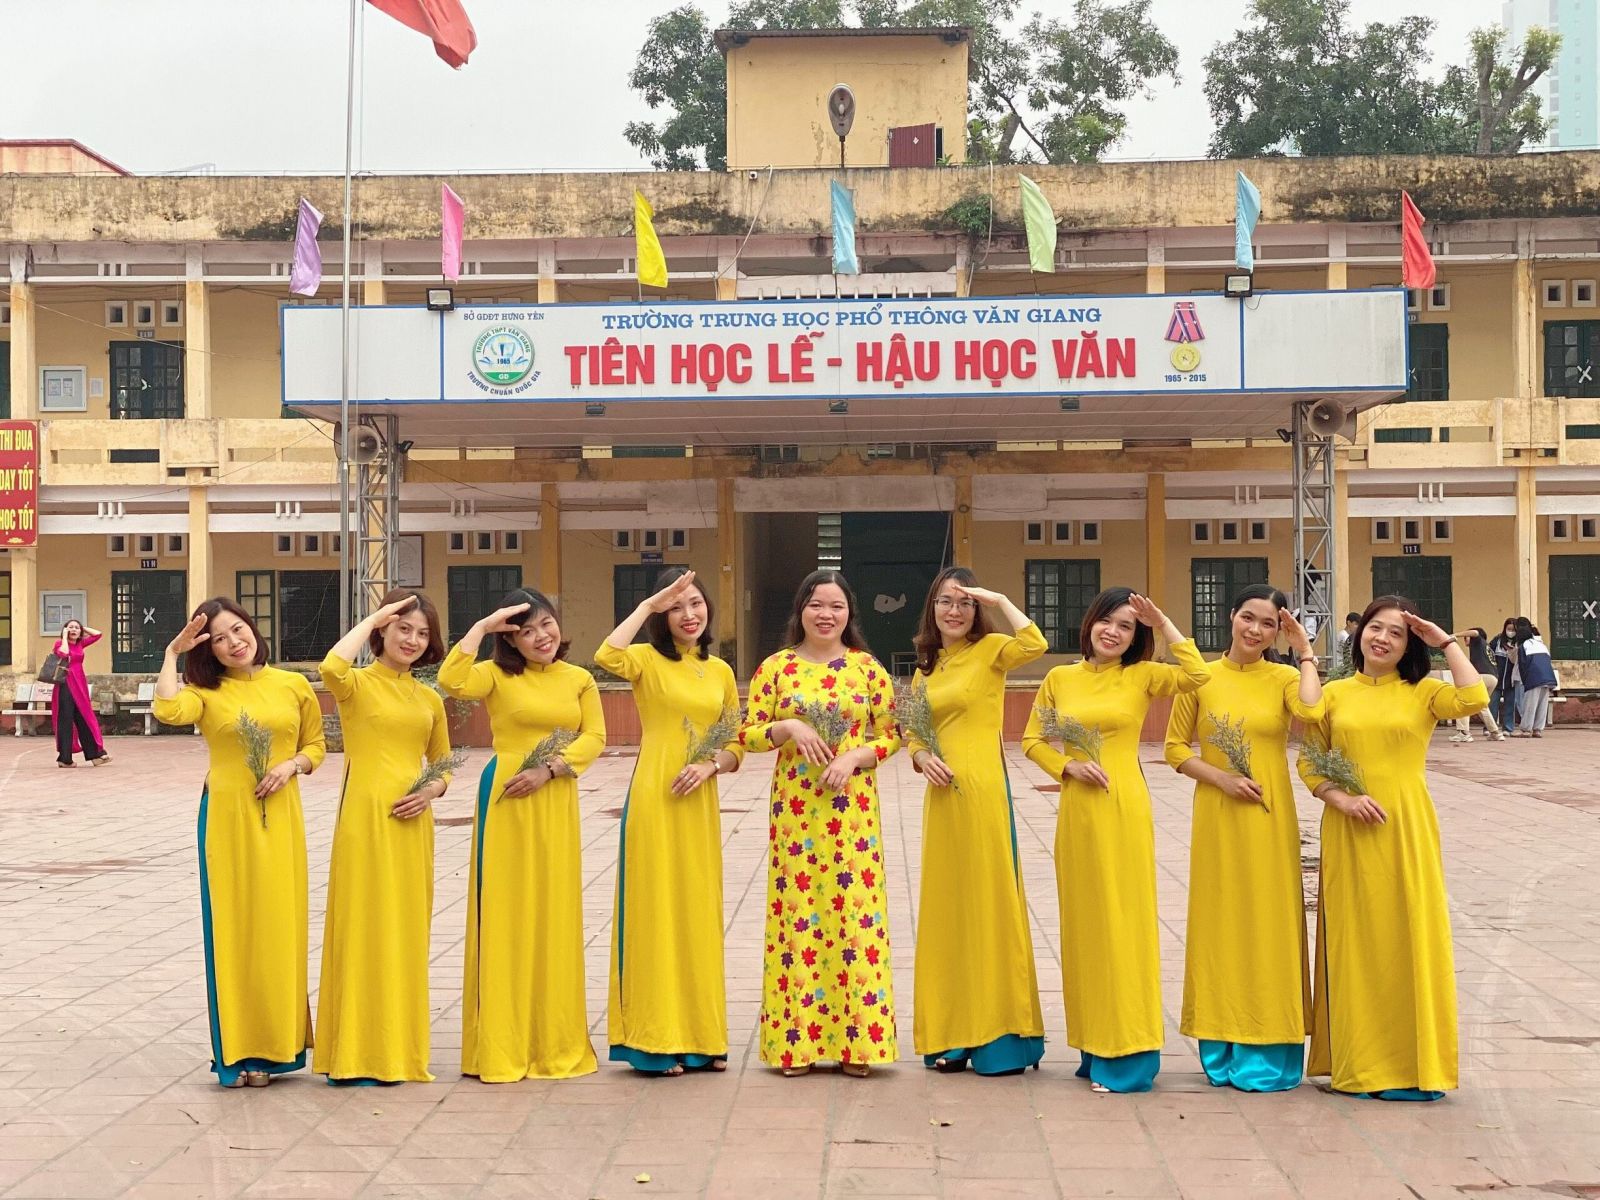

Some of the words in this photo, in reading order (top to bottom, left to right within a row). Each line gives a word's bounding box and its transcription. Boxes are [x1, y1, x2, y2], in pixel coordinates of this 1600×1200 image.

[477, 313, 499, 321] GDĐT
[501, 312, 525, 321] HƯNG
[527, 310, 544, 320] YÊN
[602, 309, 694, 329] TRƯỜNG
[699, 312, 778, 328] TRUNG
[782, 312, 830, 330] HỌC
[835, 303, 883, 326] PHỔ
[888, 306, 968, 325] THÔNG
[973, 306, 1020, 324] VĂN
[1026, 308, 1102, 323] GIANG
[564, 337, 655, 386] TIÊN
[671, 343, 753, 392] HỌC
[768, 331, 825, 384] LỄ
[856, 333, 941, 389] HẬU
[955, 339, 1037, 388] HỌC
[1052, 330, 1137, 379] VĂN
[1189, 374, 1207, 382] 2015
[0, 429, 13, 451] THI
[15, 429, 33, 451] ĐUA
[0, 468, 16, 495] DẠY
[18, 461, 34, 491] TỐT
[0, 508, 16, 536] HỌC
[18, 501, 34, 531] TỐT
